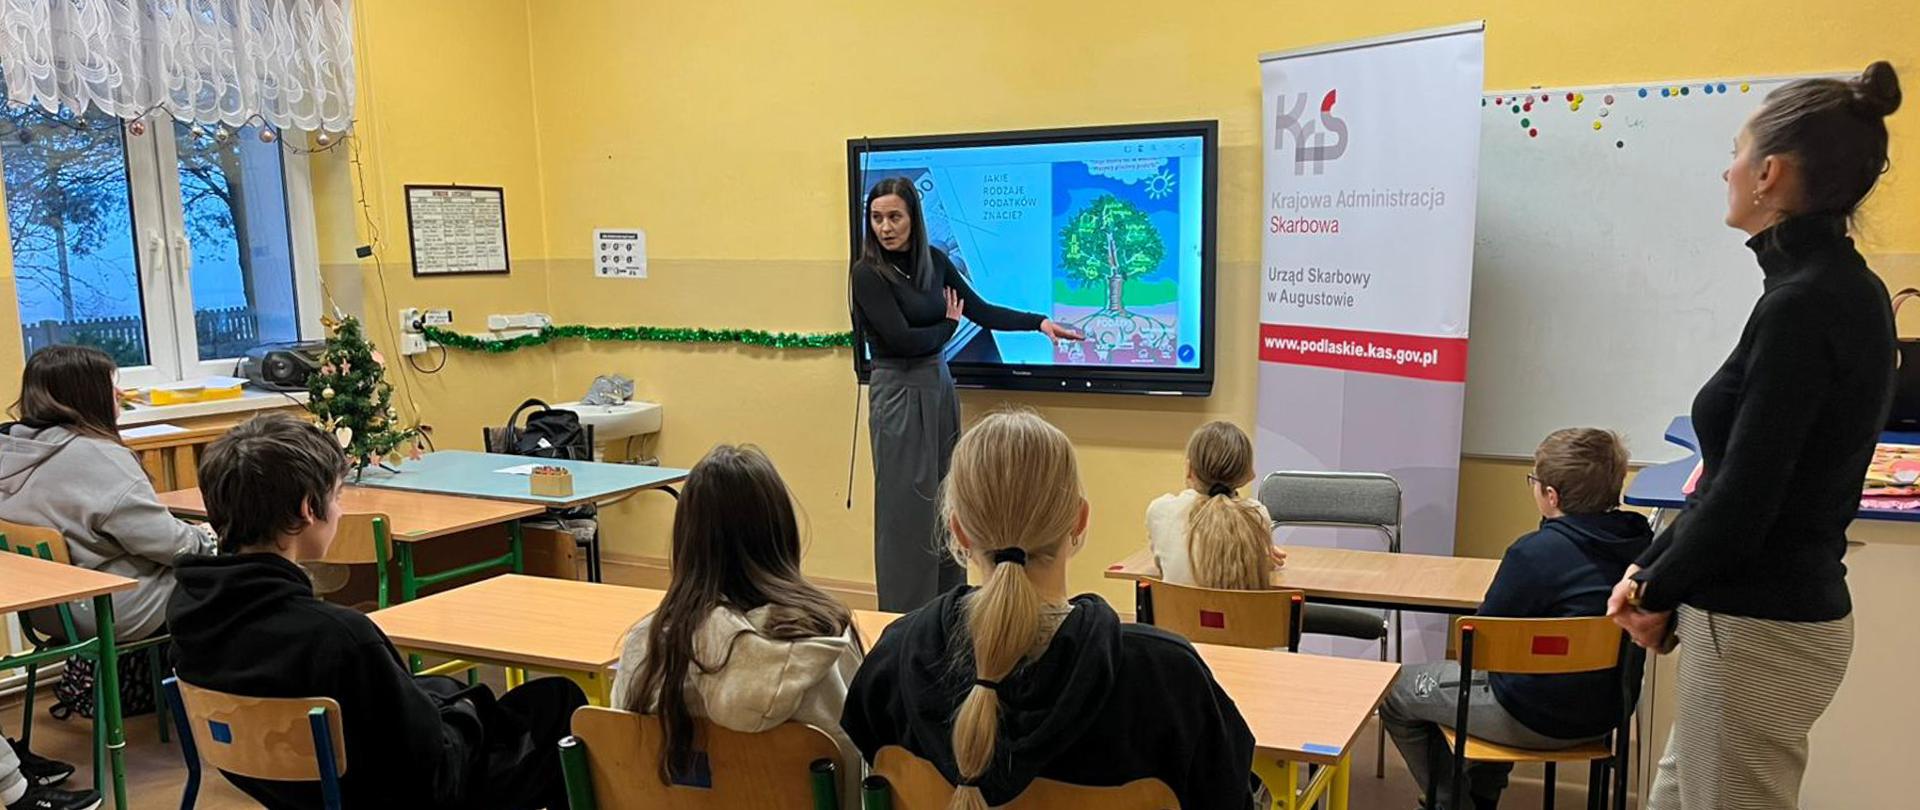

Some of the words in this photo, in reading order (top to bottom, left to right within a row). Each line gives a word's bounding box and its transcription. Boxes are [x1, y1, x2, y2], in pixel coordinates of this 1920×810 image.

[983, 173, 1008, 183] JAKIE
[983, 185, 1025, 196] RODZAJE
[1271, 191, 1331, 212] Krajowa
[1336, 187, 1445, 210] Administracja
[983, 195, 1037, 207] PODATKÓW
[983, 210, 1023, 220] ZNACIE?
[1270, 215, 1339, 234] Skarbowa
[1268, 266, 1304, 286] Urząd
[1308, 267, 1371, 288] Skarbowy
[1267, 291, 1277, 303] w
[1279, 289, 1354, 308] Augustowie
[1264, 337, 1439, 367] www.podlaskie.kas.gov.pl
